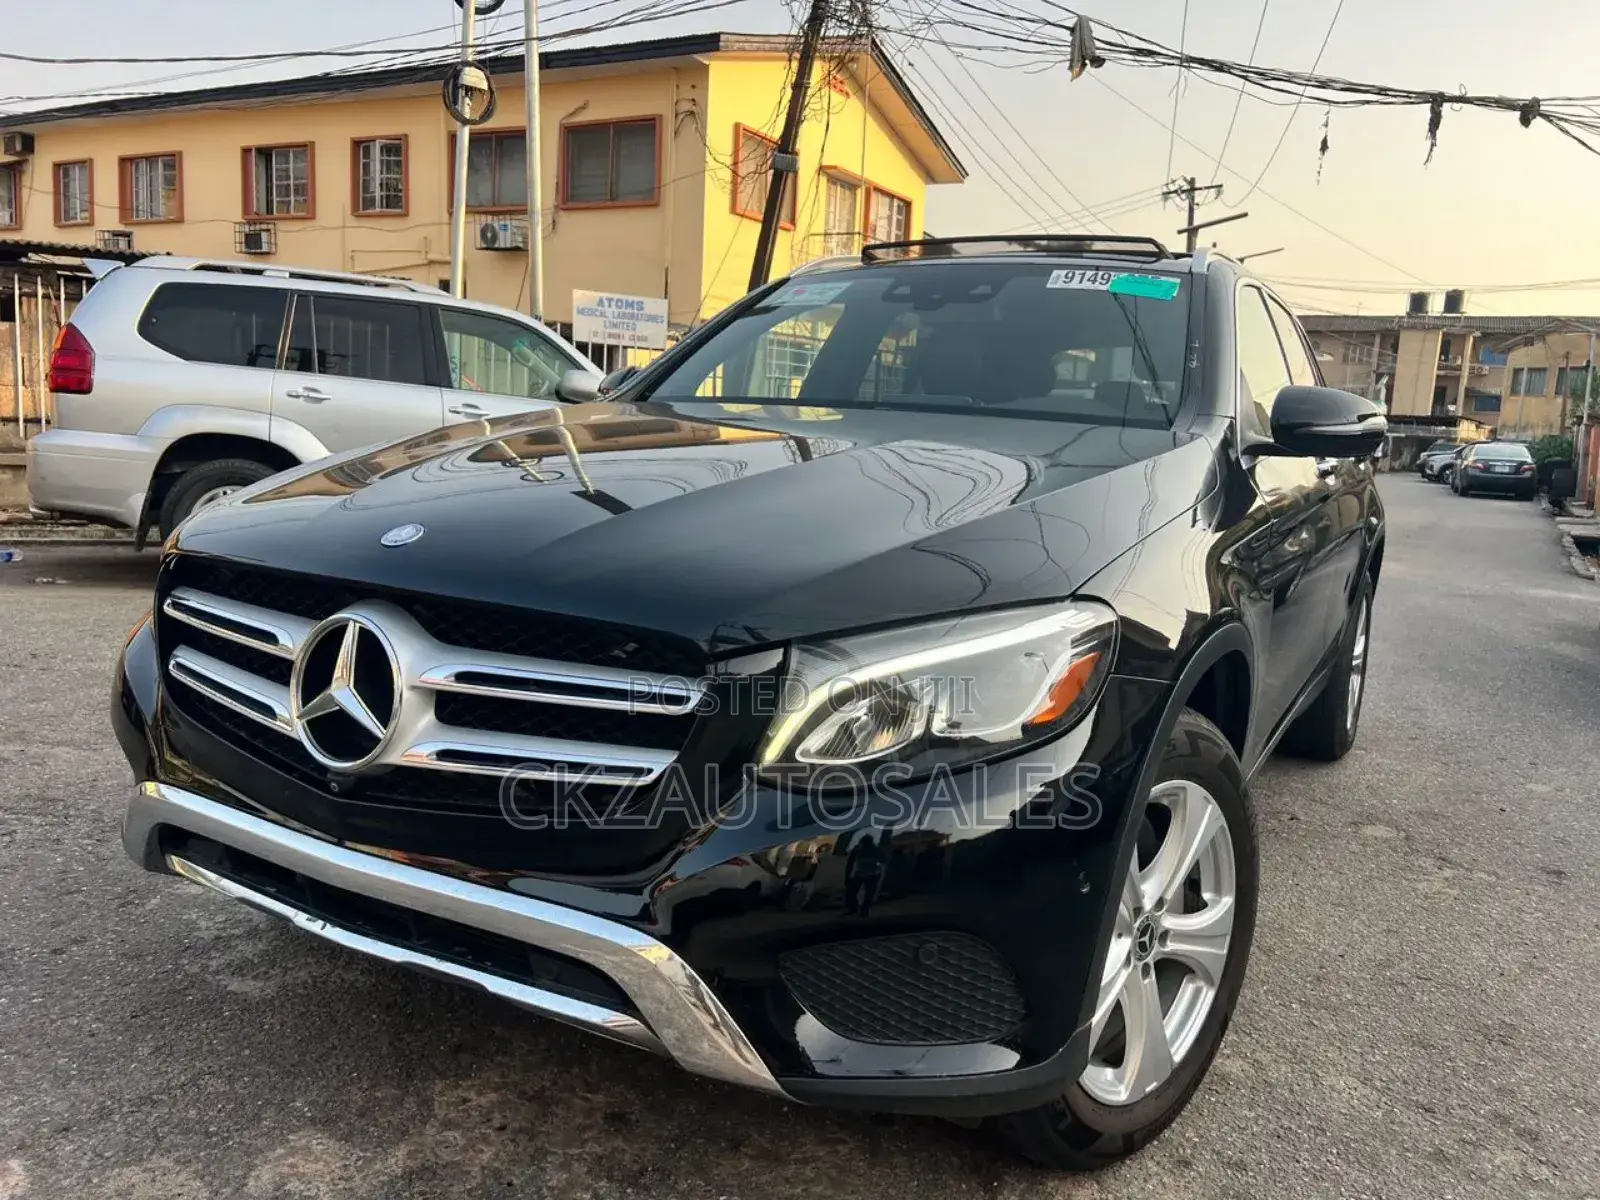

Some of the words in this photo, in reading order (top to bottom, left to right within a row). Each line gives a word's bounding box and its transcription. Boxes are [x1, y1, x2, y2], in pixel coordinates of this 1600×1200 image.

[597, 297, 644, 311] ATOMS
[577, 307, 609, 318] MEDICAL
[604, 320, 637, 331] LIMITED
